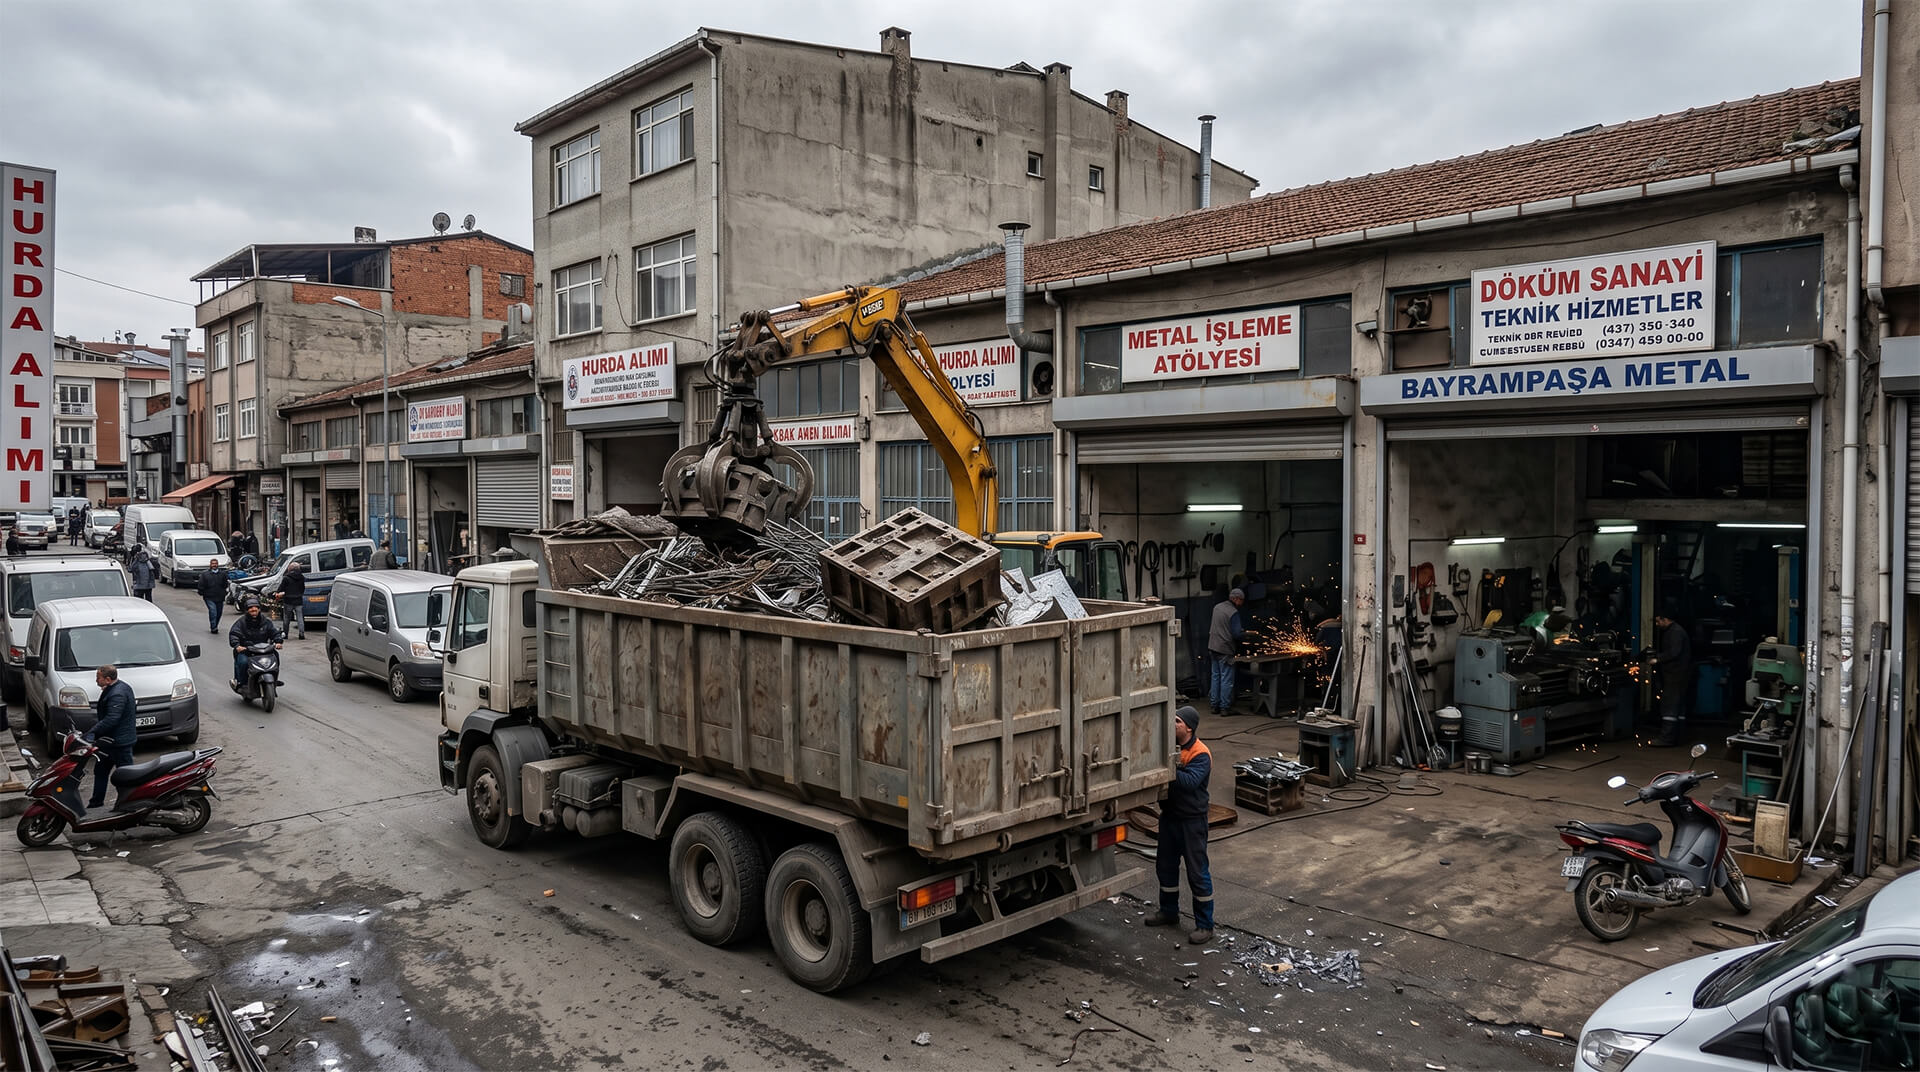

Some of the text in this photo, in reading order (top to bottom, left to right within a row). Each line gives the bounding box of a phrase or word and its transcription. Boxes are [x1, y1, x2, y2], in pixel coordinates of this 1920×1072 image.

[1480, 249, 1703, 303] DÖKÜM SANAYİ
[1481, 290, 1703, 328] TEKNİK HİZMETLER
[6, 177, 45, 504] HURDA ALIMI
[1128, 314, 1292, 350] METAL İŞLEME
[1488, 332, 1522, 344] TEKNİK
[1595, 331, 1704, 351] (0347) 459 00-00
[1602, 323, 1635, 337] (437)
[582, 347, 668, 377] HURDA ALIMI
[939, 345, 1015, 370] HURDA ALIMI
[1153, 341, 1261, 374] ATÖLYESİ
[948, 369, 995, 390] OLYESİ
[1401, 357, 1750, 394] BAYRAMPAŞA METAL
